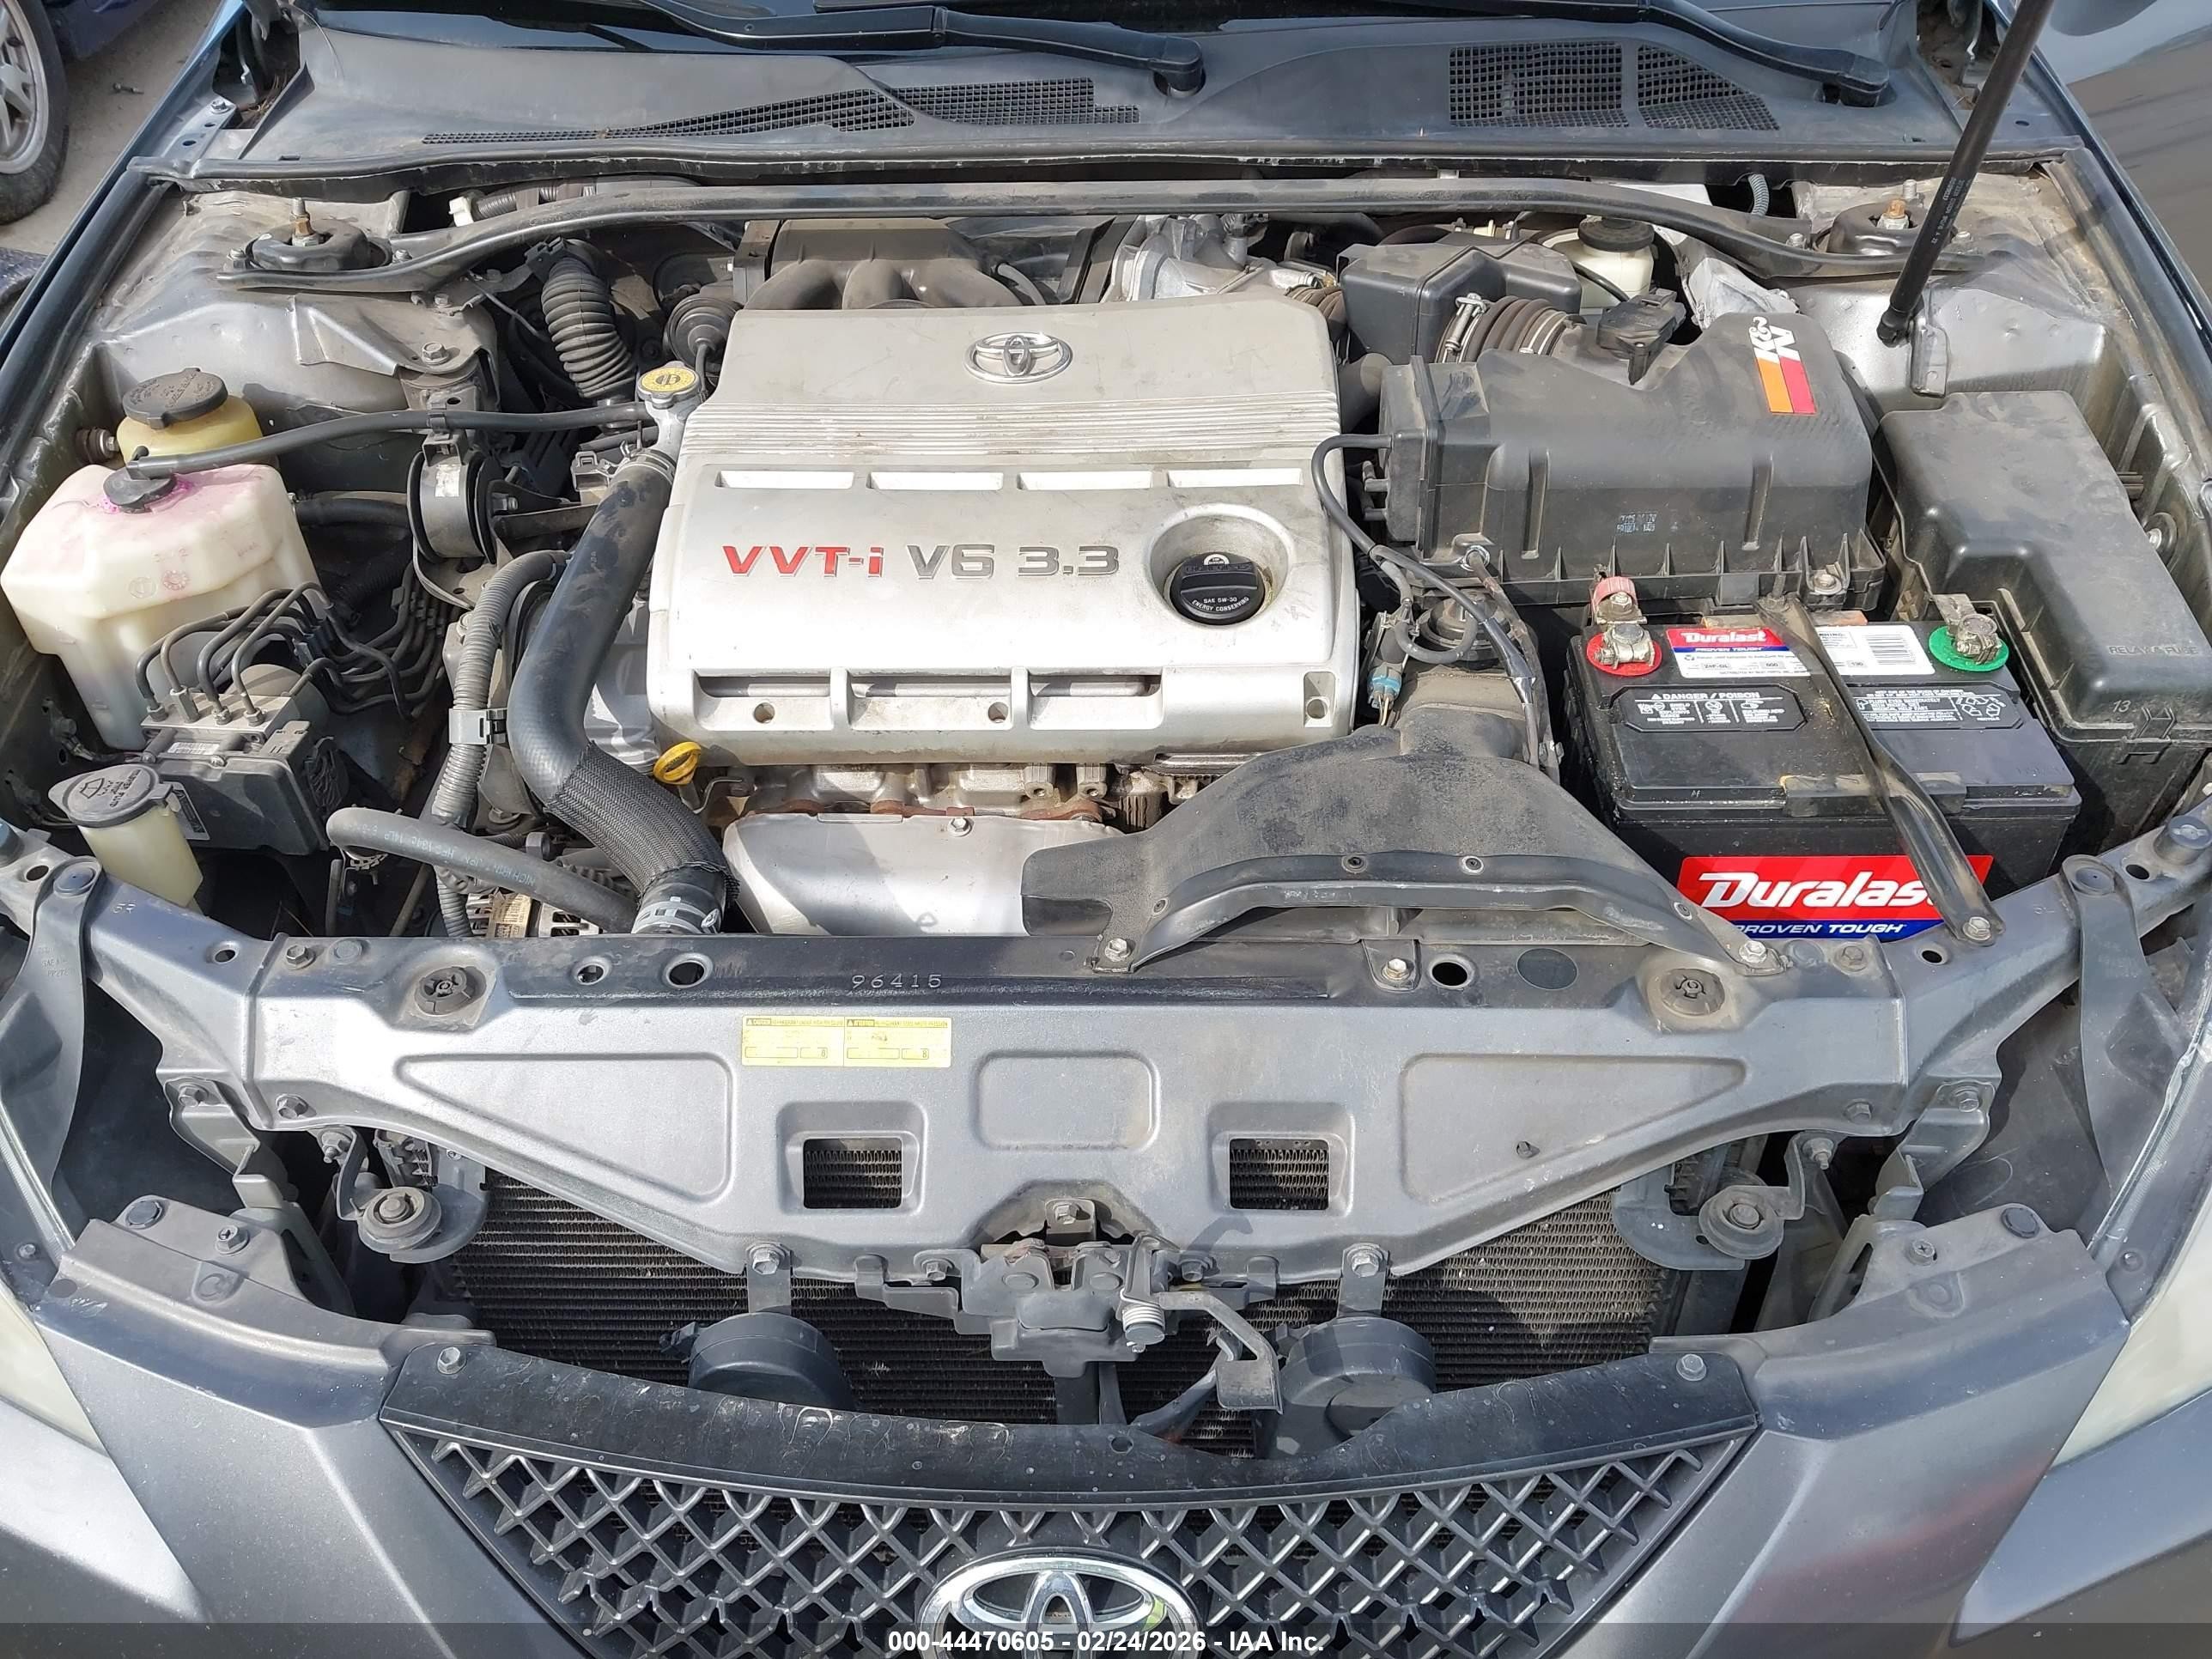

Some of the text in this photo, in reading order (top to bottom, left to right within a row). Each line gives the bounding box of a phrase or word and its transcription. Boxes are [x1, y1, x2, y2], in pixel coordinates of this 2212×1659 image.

[722, 544, 1121, 580] VVT-i V6 3.3
[1191, 597, 1249, 611] ENERGY CONSERVING
[1680, 631, 1766, 643] Duralast
[2112, 700, 2132, 713] 13
[1698, 871, 1936, 908] Duralas
[1828, 923, 1904, 934] TOUGH
[851, 974, 943, 989] 96415
